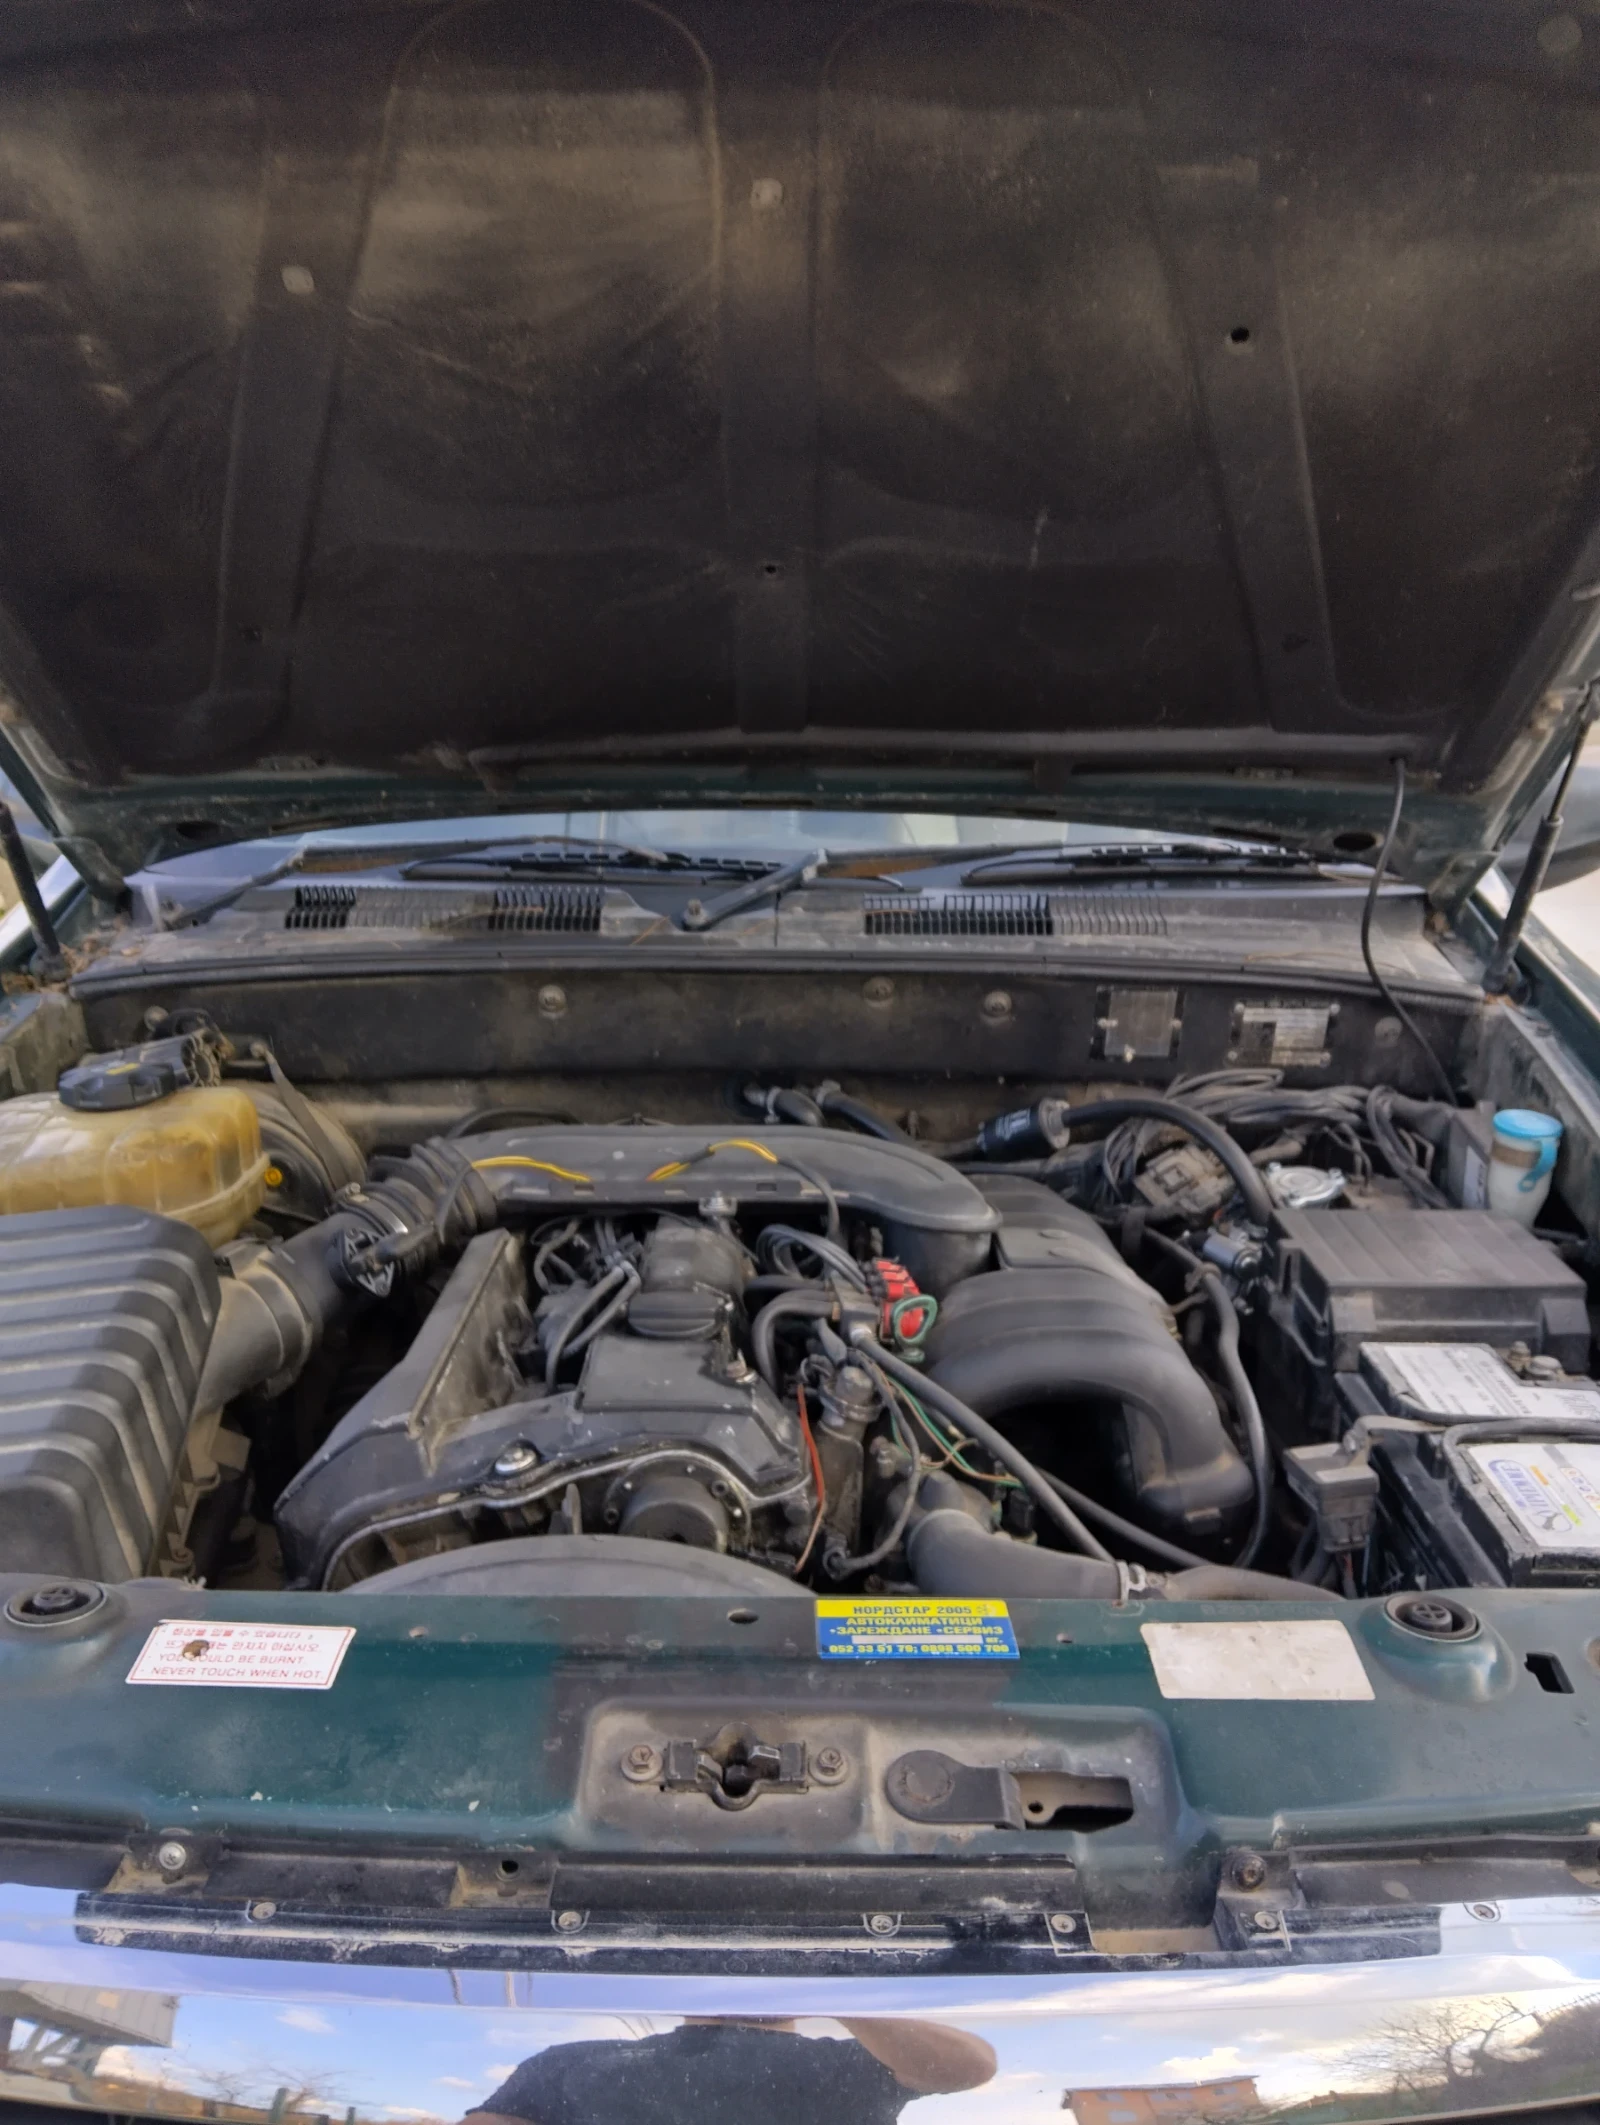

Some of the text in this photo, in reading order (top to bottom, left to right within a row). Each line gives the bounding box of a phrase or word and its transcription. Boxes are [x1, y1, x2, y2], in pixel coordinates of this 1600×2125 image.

[853, 1606, 971, 1615] НОРДСТАР 2005
[846, 1617, 983, 1626] АВТОКЛИМАТИЦИ
[190, 1653, 235, 1663] OULD
[238, 1655, 256, 1663] BE
[151, 1666, 197, 1675] NEVER
[201, 1667, 246, 1677] TOUCH
[250, 1669, 290, 1678] WHEN
